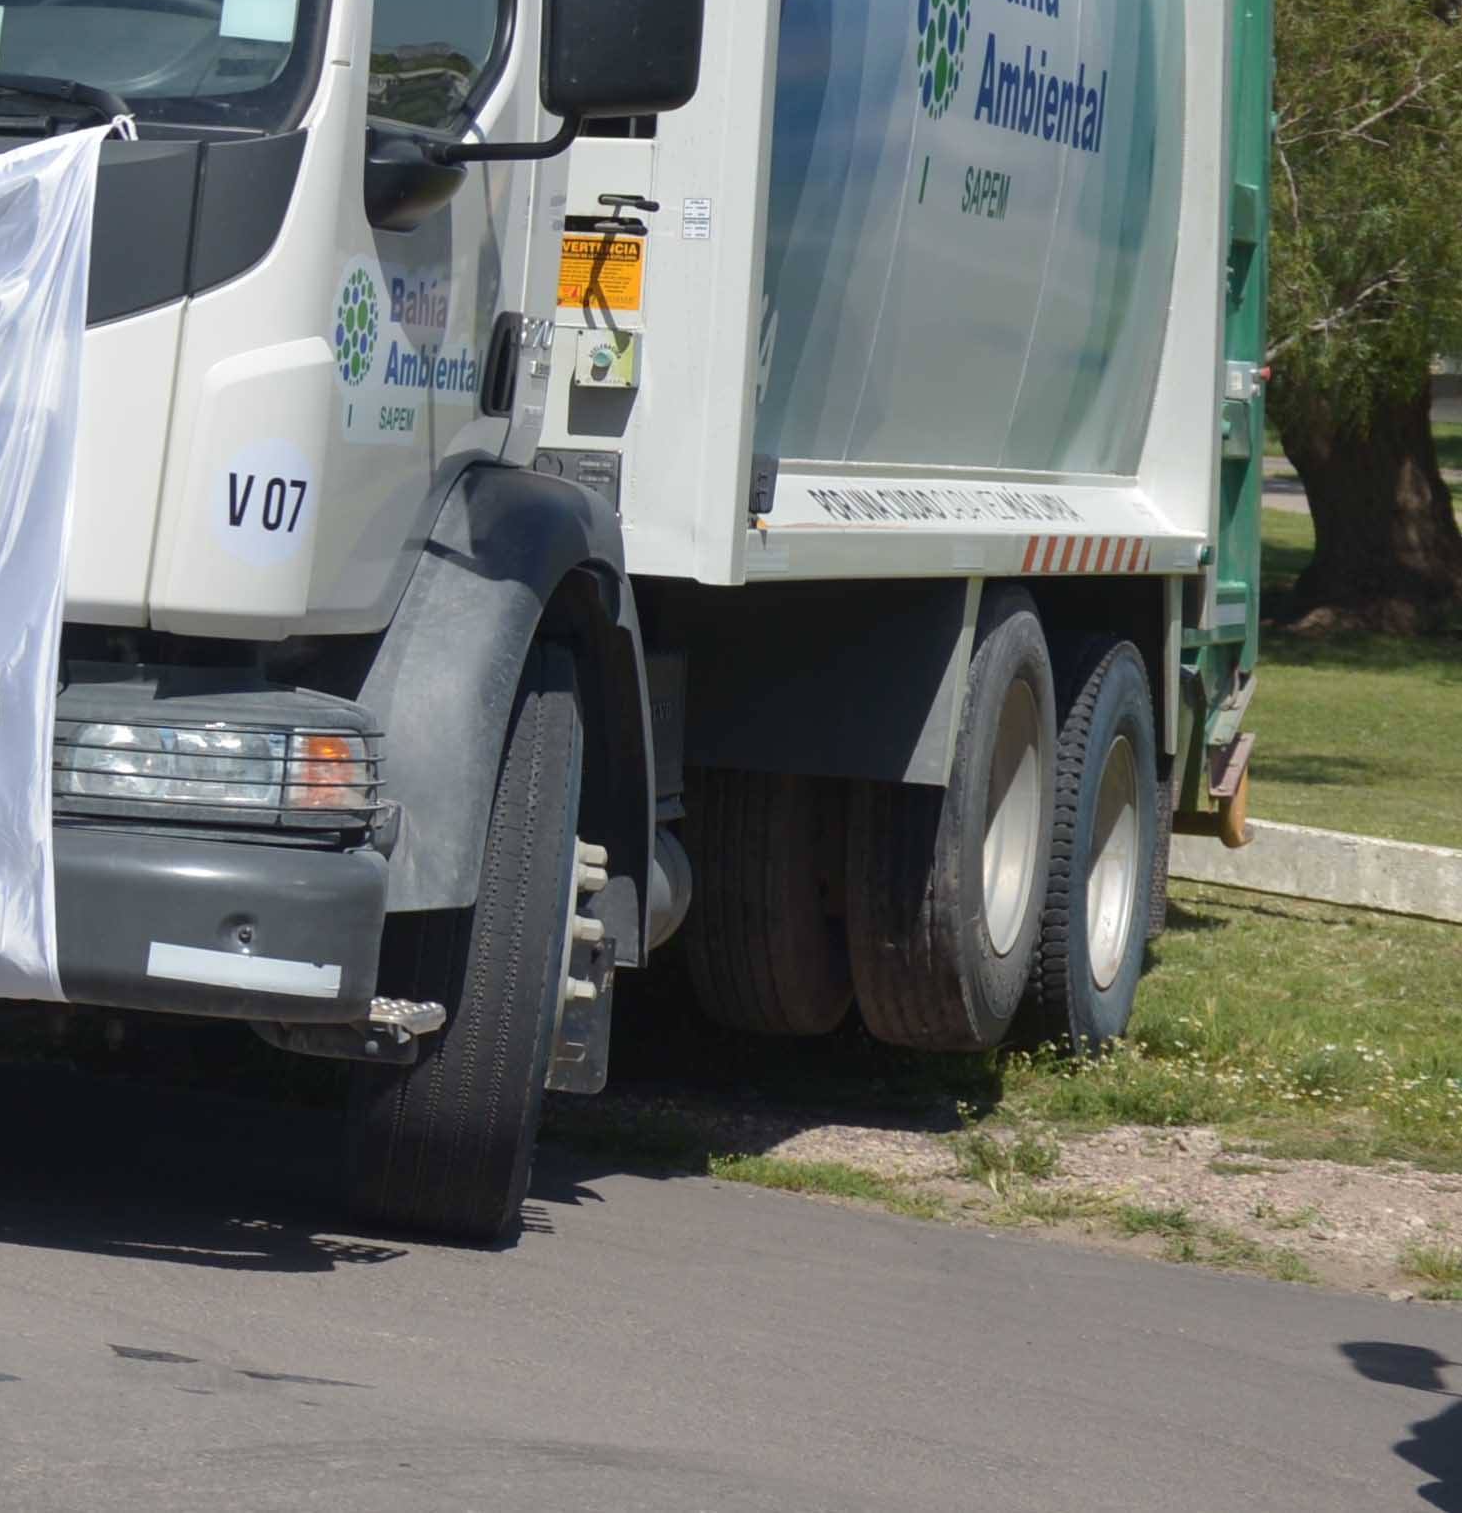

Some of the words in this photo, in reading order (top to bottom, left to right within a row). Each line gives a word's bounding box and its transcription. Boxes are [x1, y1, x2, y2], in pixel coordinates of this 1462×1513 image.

[974, 32, 1107, 154] Ambiental
[962, 166, 1011, 223] SAPEM
[389, 276, 449, 330] Bahía
[383, 340, 484, 394] Ambiental
[378, 405, 415, 432] SAPEM
[227, 470, 259, 531] V
[263, 476, 308, 535] 07
